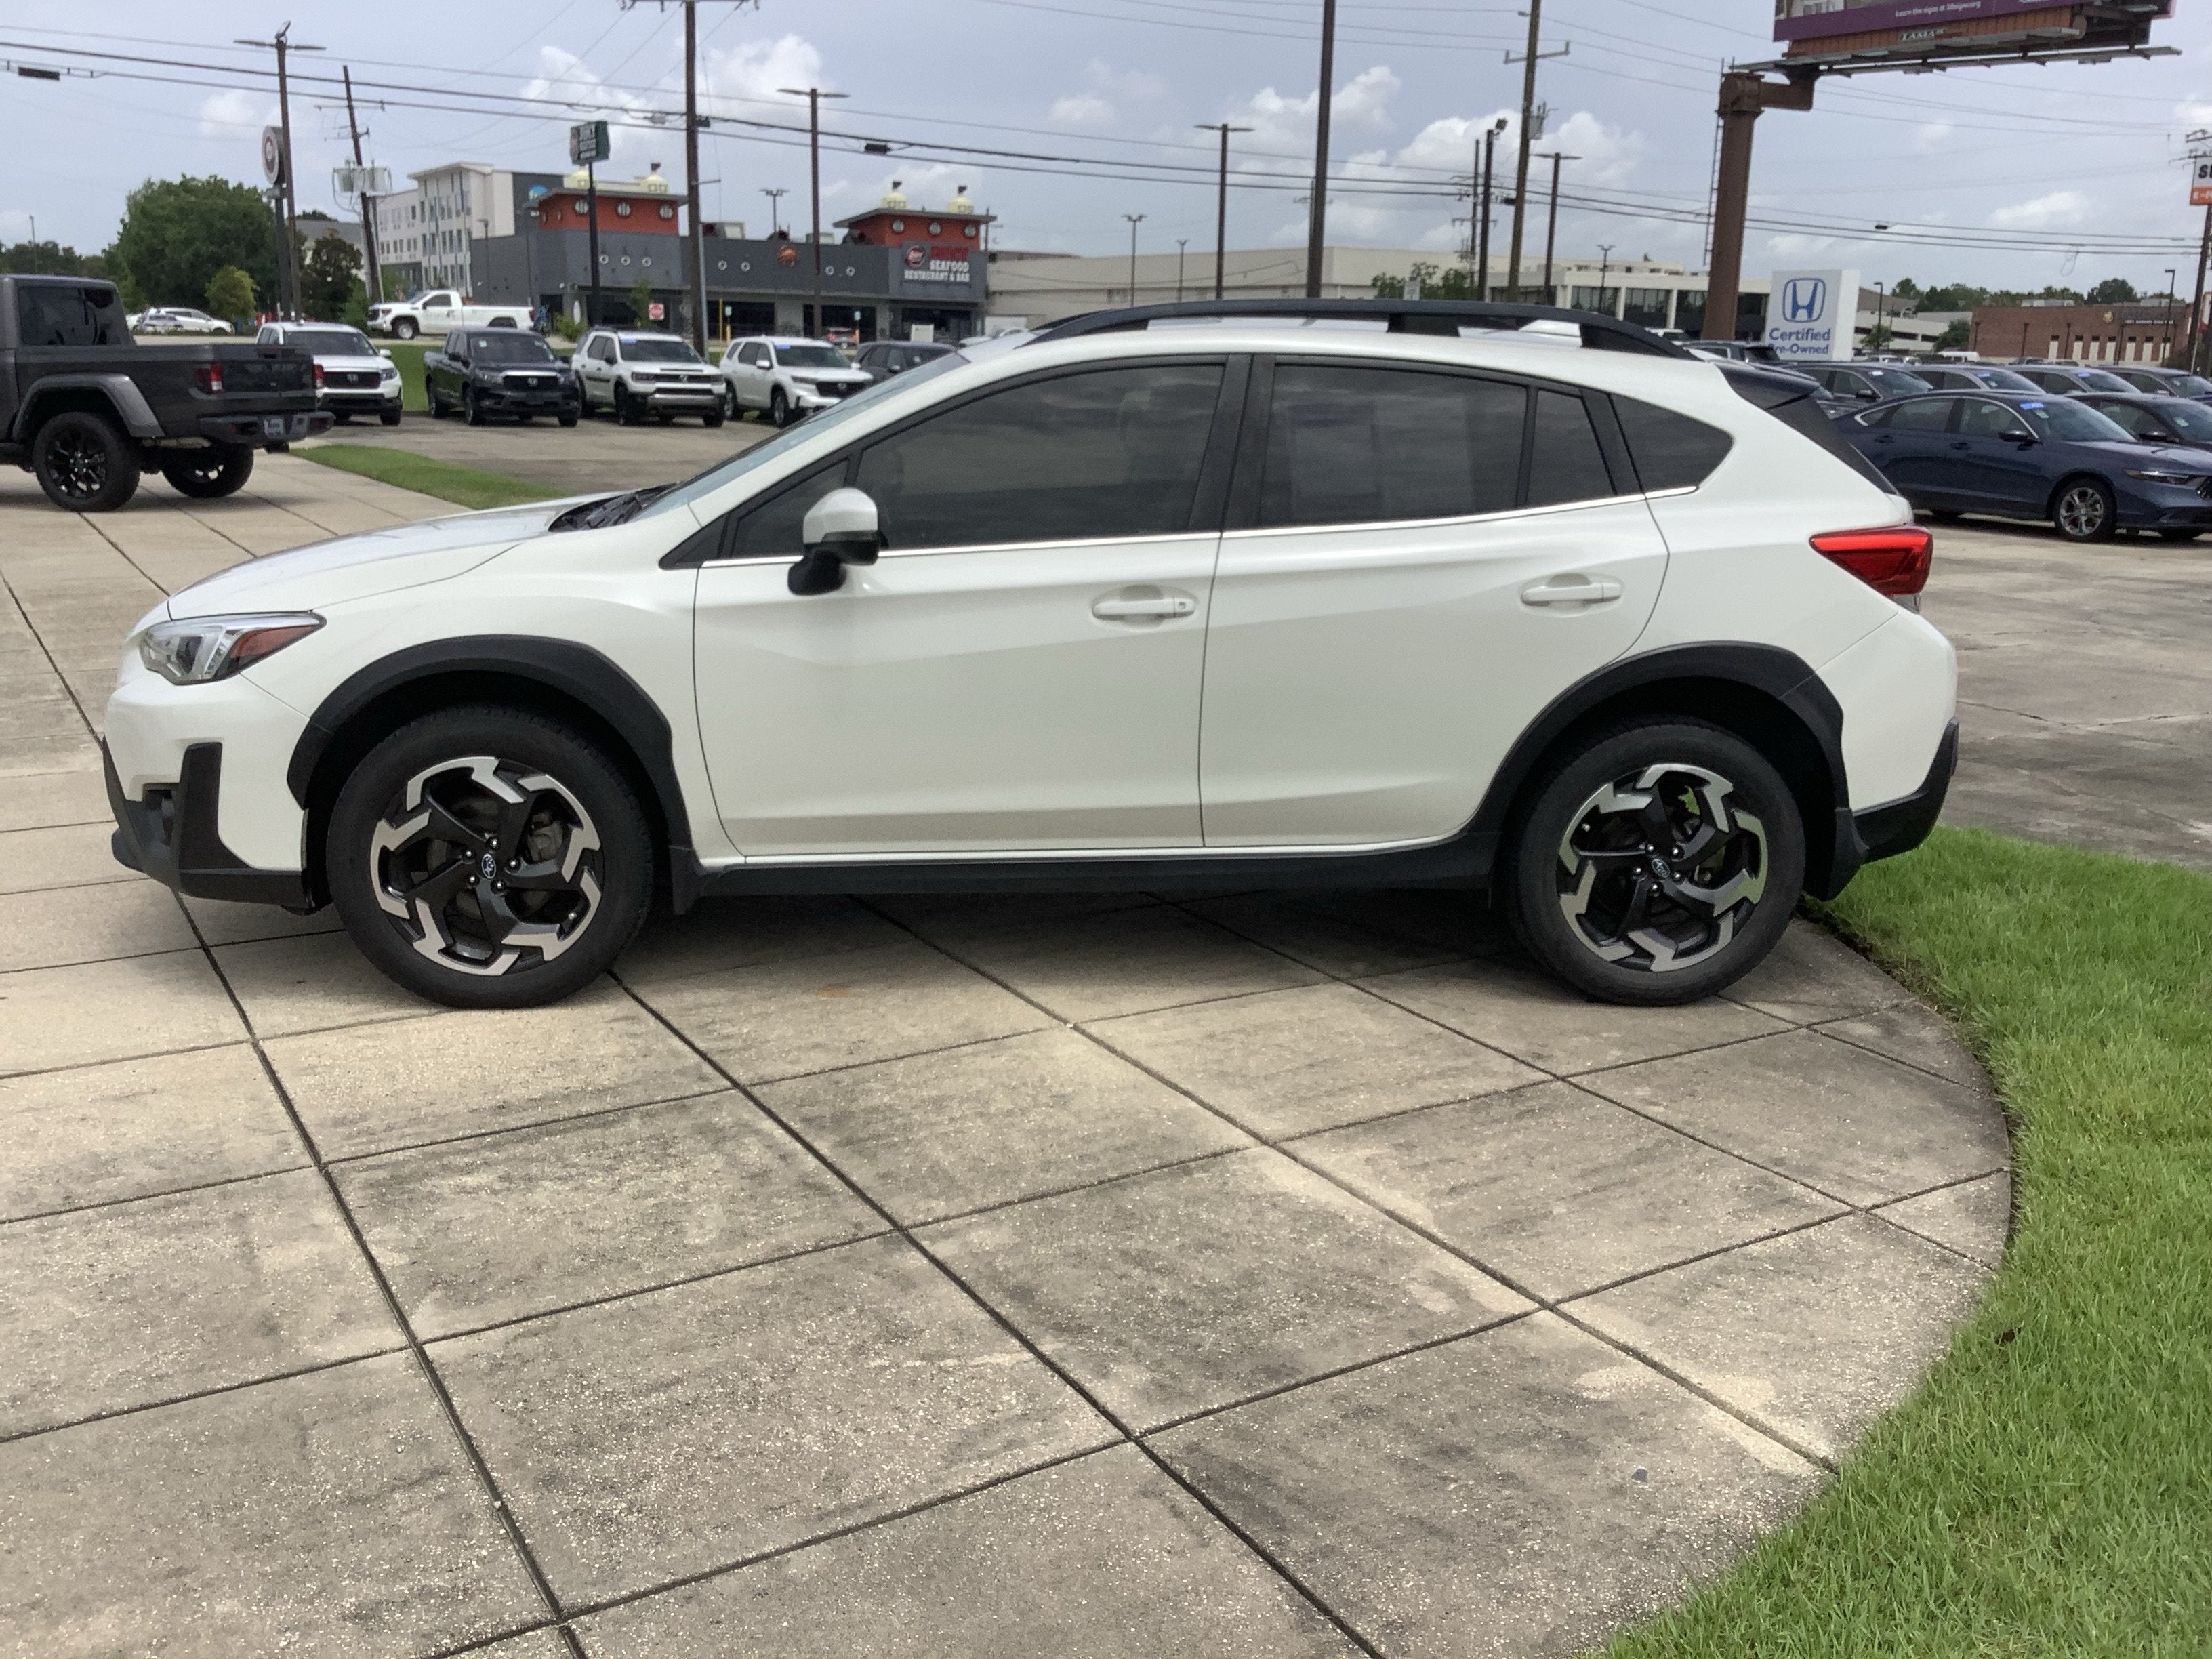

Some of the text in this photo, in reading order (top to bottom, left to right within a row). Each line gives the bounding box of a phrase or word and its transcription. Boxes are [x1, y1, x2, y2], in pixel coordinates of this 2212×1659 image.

[929, 260, 970, 272] SEAFOOD
[904, 270, 949, 281] RESTAURANT
[956, 272, 970, 283] BAR
[1769, 327, 1831, 342] Certified
